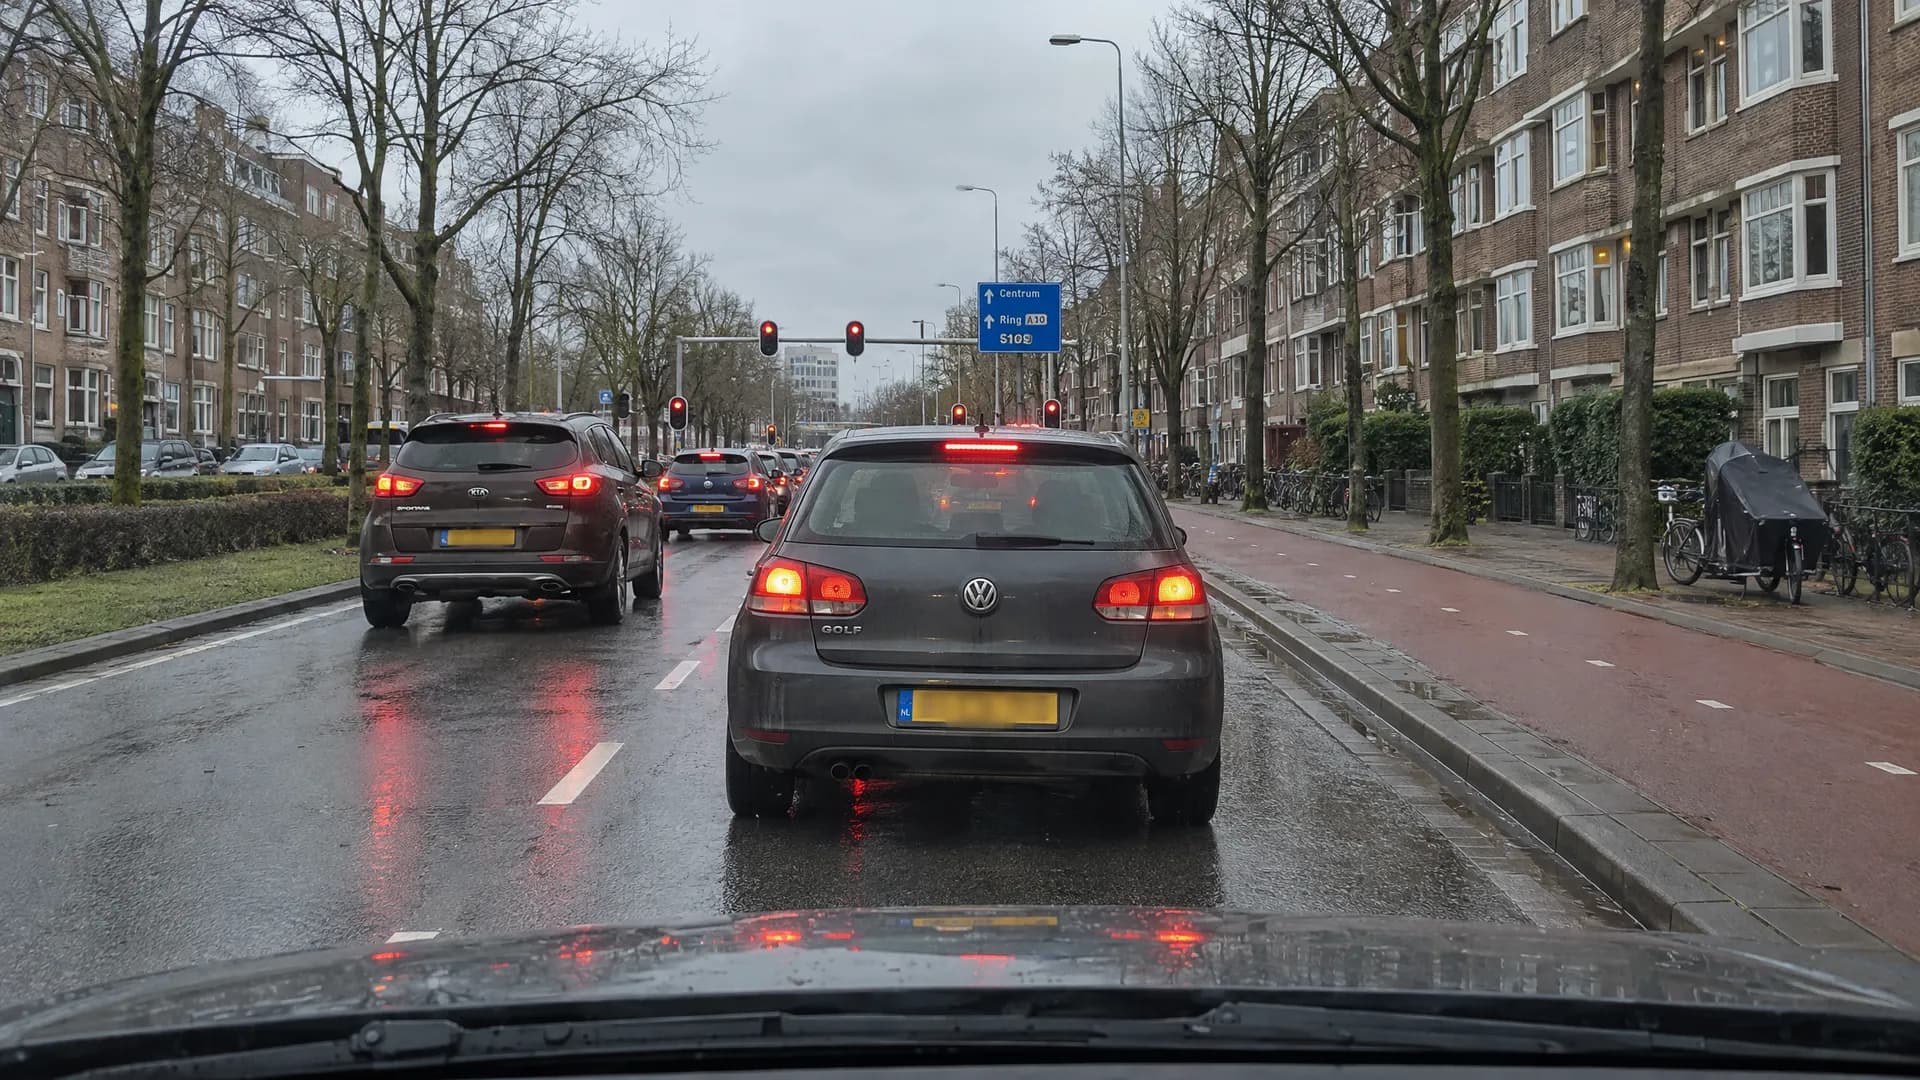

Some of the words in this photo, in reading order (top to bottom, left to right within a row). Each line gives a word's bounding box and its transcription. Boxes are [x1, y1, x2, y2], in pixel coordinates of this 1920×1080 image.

[1000, 289, 1040, 298] Centrum
[1000, 315, 1022, 326] Ring
[1027, 315, 1045, 324] A10
[470, 488, 487, 496] KIA
[821, 624, 863, 636] GOLF
[900, 708, 911, 717] NL
